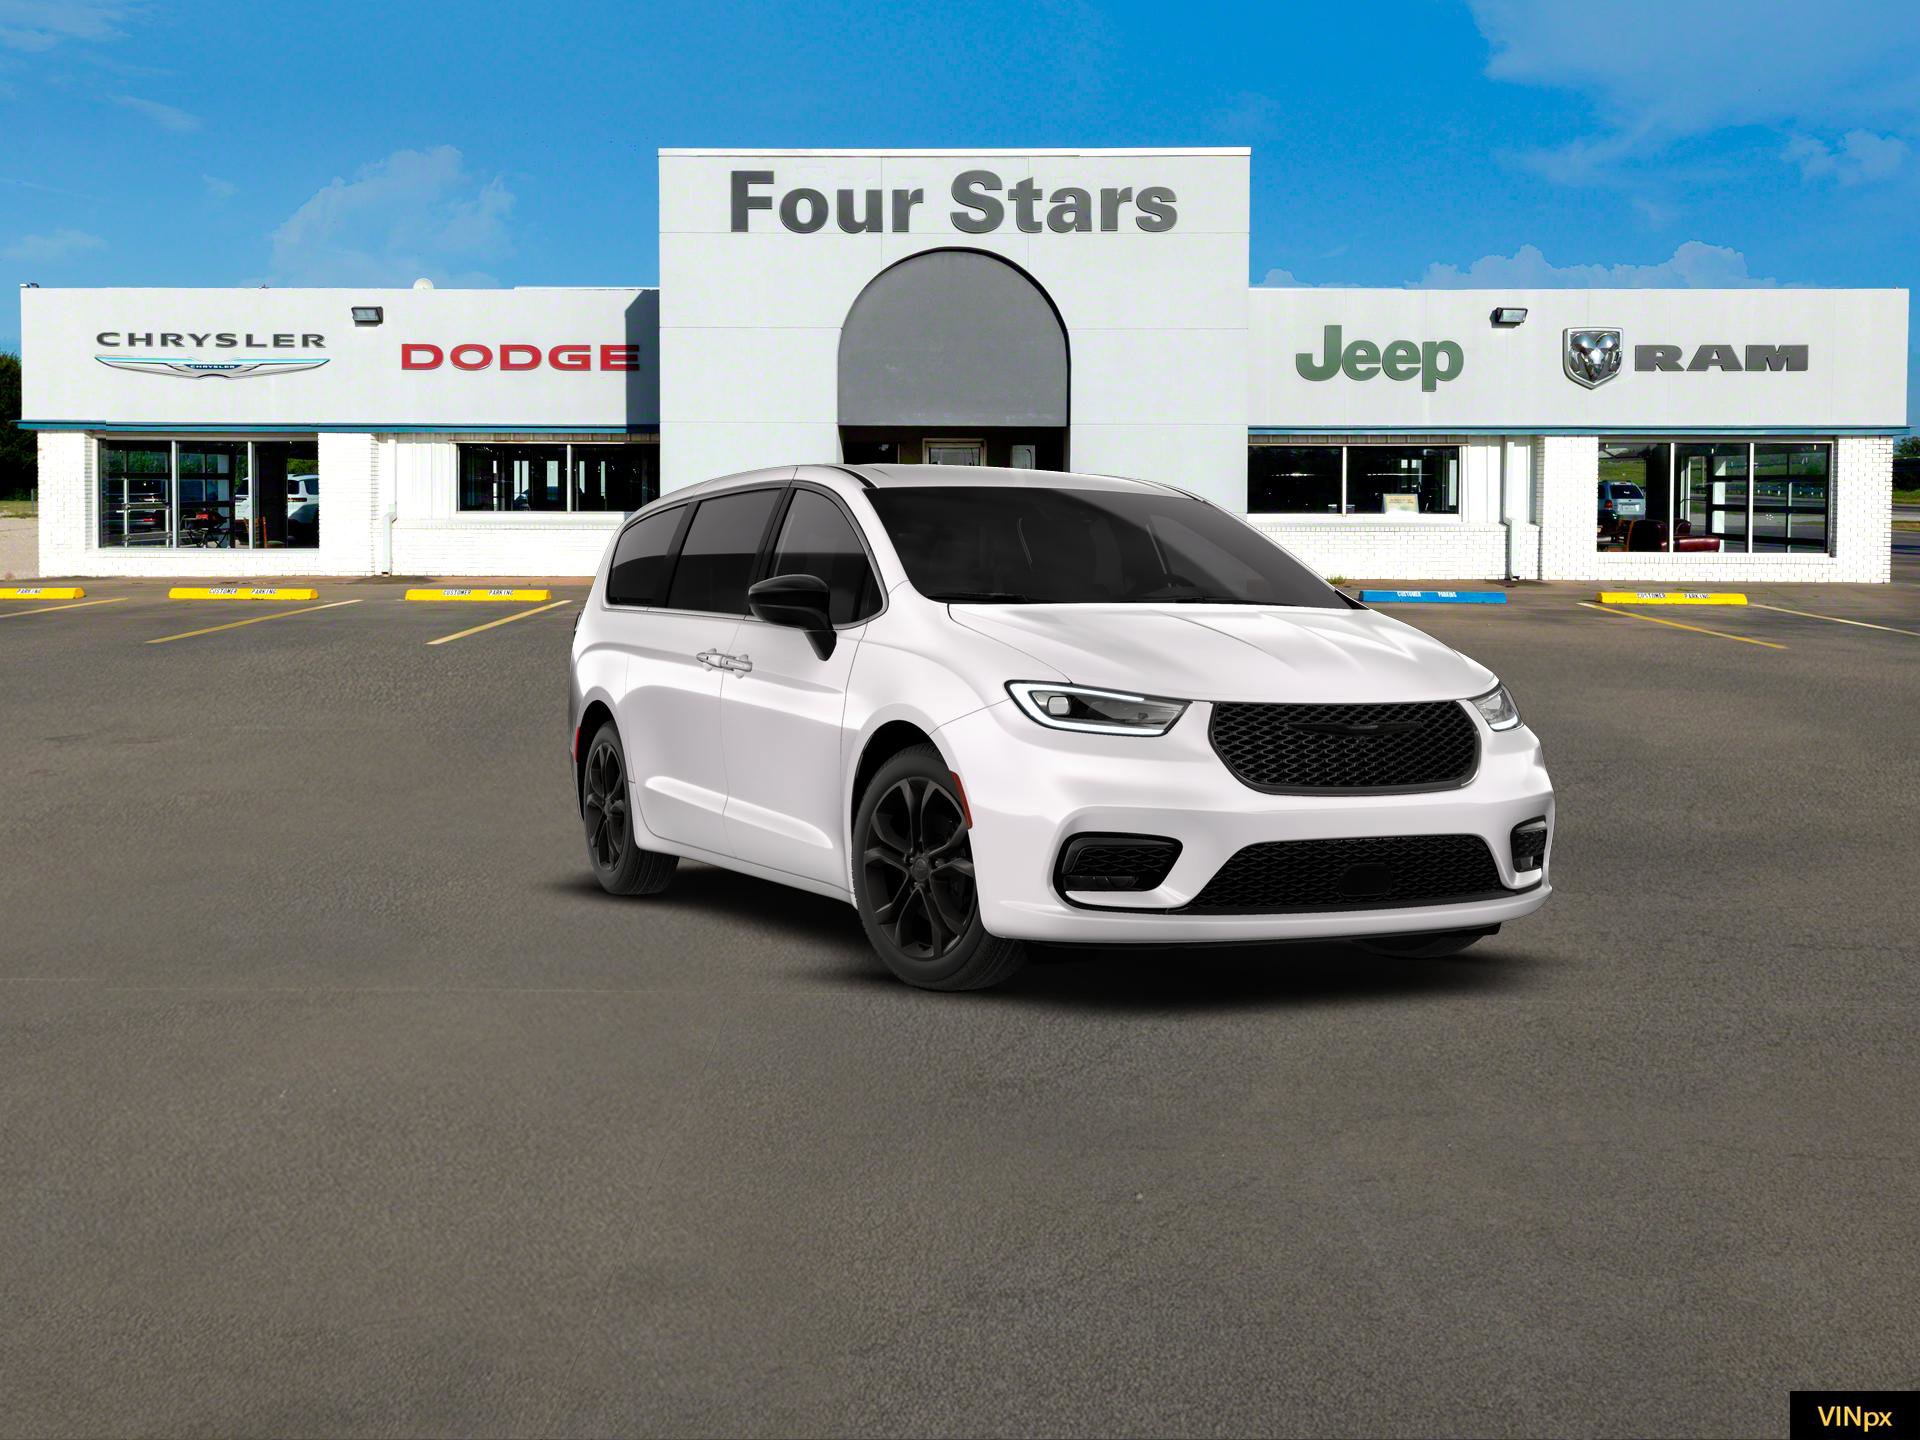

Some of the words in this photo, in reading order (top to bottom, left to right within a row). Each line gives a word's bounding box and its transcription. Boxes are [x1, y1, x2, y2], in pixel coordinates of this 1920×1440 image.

[730, 170, 924, 234] Four
[950, 170, 1178, 234] Stars
[96, 331, 327, 349] CHRYSLER
[401, 342, 641, 372] DODGE
[1295, 325, 1464, 393] Jeep
[1634, 343, 1809, 372] RAM
